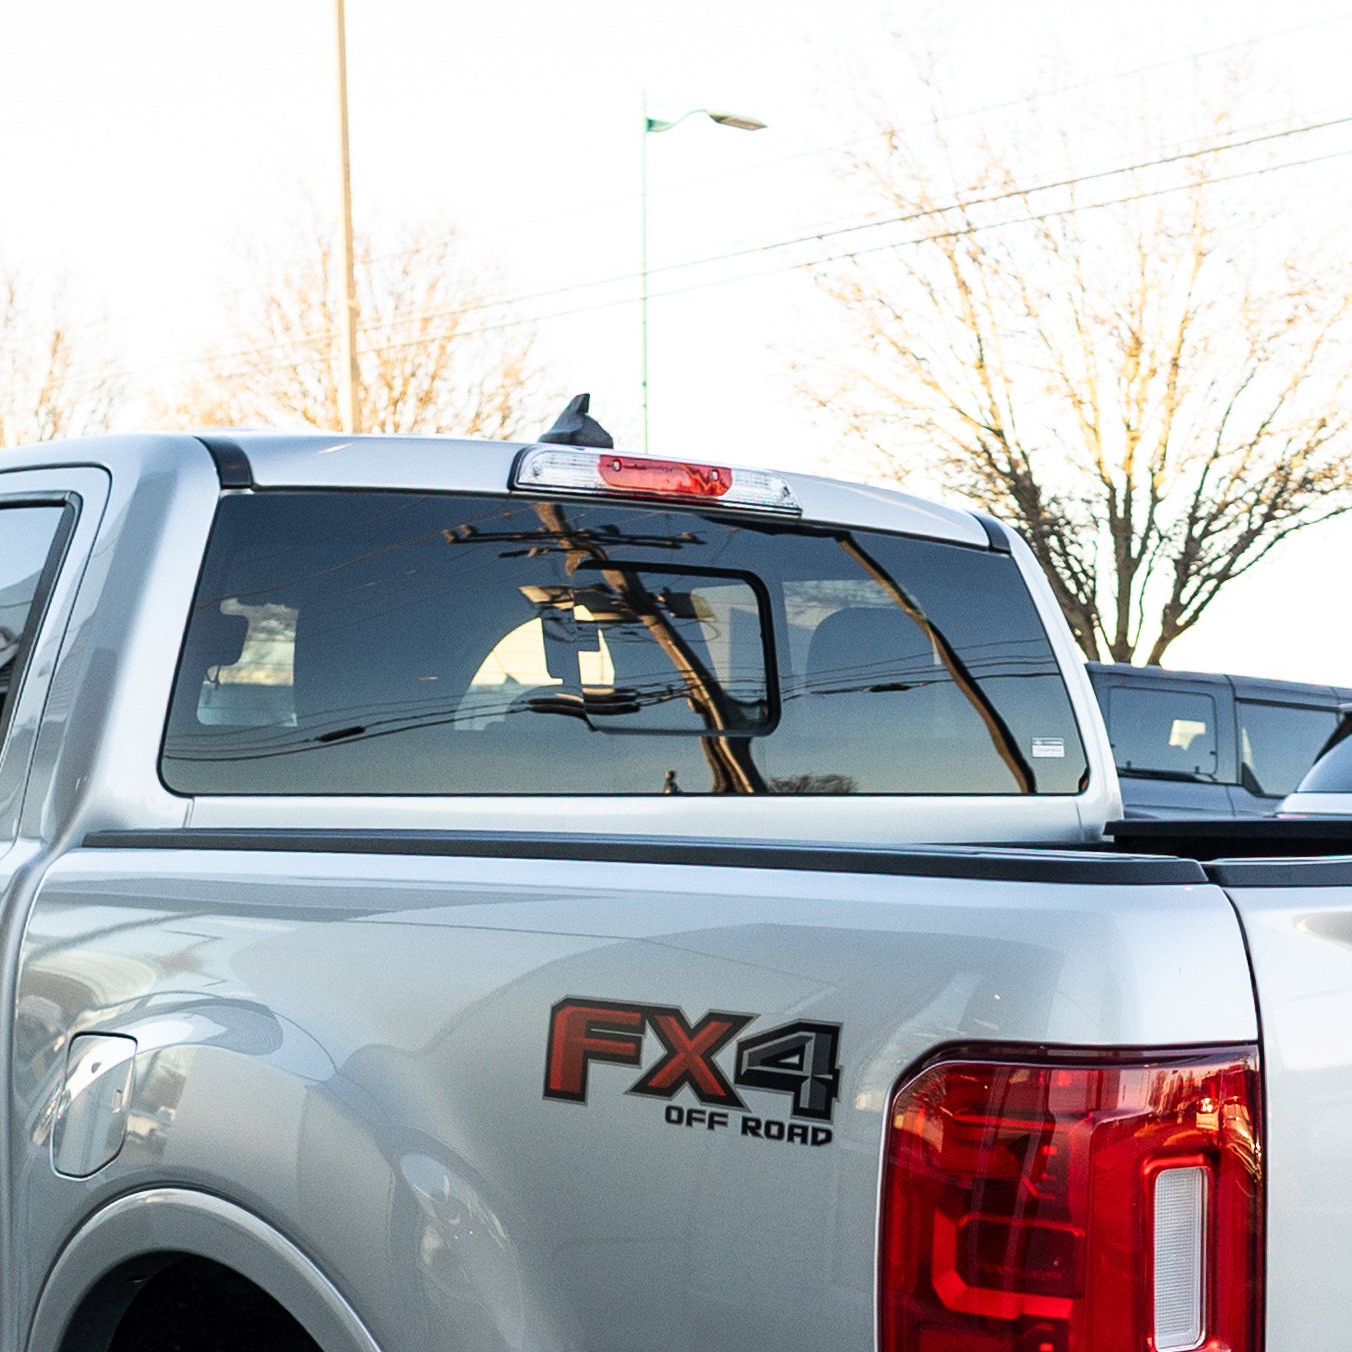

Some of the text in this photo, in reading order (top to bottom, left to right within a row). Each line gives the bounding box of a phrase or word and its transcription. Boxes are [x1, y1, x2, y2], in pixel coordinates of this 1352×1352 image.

[542, 993, 844, 1125] FX4
[664, 1104, 834, 1148] OFF ROAD
